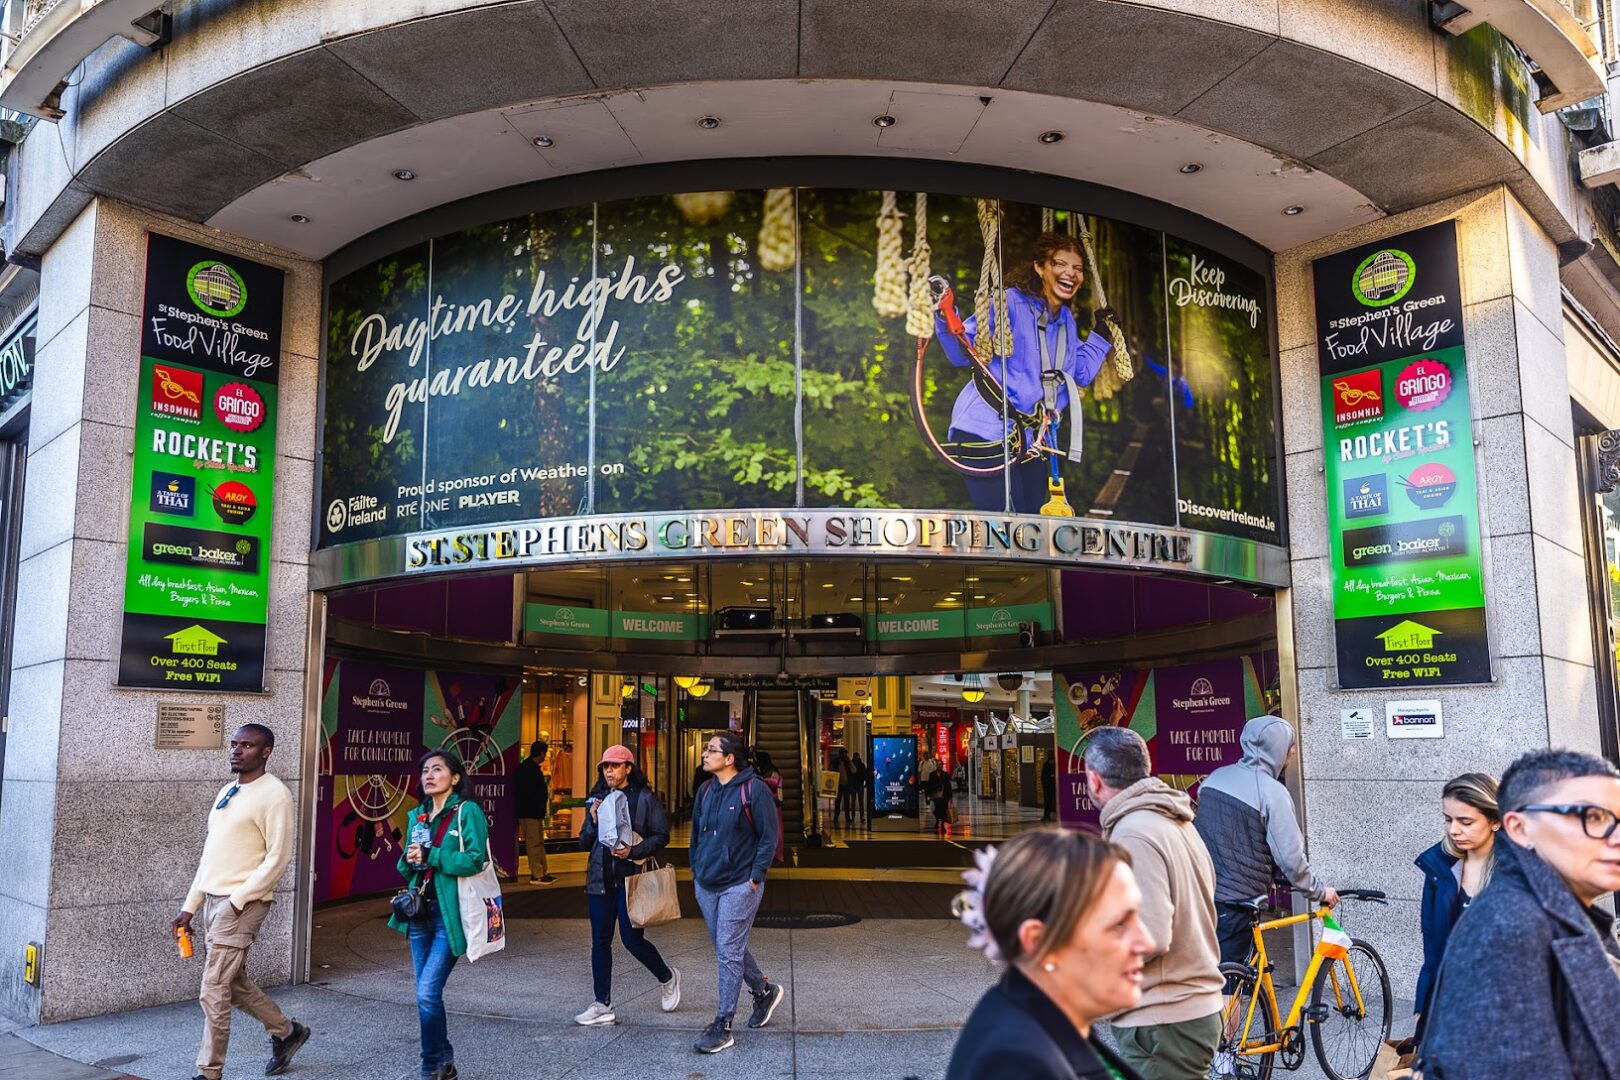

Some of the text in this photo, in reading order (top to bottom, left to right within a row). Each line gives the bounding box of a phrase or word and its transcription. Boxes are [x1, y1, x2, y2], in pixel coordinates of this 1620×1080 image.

[1191, 254, 1225, 292] Keep
[1169, 278, 1261, 329] Discovering
[1338, 305, 1400, 329] Stephen's
[1403, 295, 1446, 312] Green
[352, 255, 685, 372] Daytime highs
[167, 306, 229, 331] Stephen's
[231, 323, 269, 340] Green
[1325, 312, 1455, 360] Food Village
[152, 316, 273, 377] Food Village
[1416, 367, 1426, 375] EL
[383, 320, 626, 444] guaranteed
[1399, 373, 1446, 397] GRINGO
[236, 388, 243, 398] EL
[153, 401, 199, 418] INSOMNIA
[218, 396, 260, 417] GRINGO
[1336, 406, 1381, 422] INSOMNIA
[152, 428, 257, 469] ROCKET'S
[1340, 420, 1450, 462] ROCKET'S
[397, 480, 435, 498] Proud
[438, 473, 496, 494] sponsor
[500, 468, 517, 484] of
[601, 463, 624, 475] on
[157, 494, 189, 508] THAI
[225, 492, 248, 502] AROY
[349, 494, 377, 511] Fáilte
[458, 489, 520, 509] PLAYER
[1350, 496, 1382, 510] THAI
[348, 509, 386, 527] Ireland
[657, 515, 811, 550] GREEN
[825, 515, 1041, 552] SHOPPING
[1052, 524, 1193, 563] CENTRE
[153, 543, 192, 555] green
[198, 545, 237, 561] baker
[1352, 537, 1440, 559] green baker
[138, 574, 151, 587] All
[151, 575, 166, 592] day
[1344, 578, 1355, 592] All
[1356, 578, 1370, 594] day
[169, 590, 200, 607] Burgers
[201, 594, 208, 605] &
[1375, 589, 1406, 605] Burgers
[1407, 587, 1414, 599] &
[539, 617, 591, 629] Stephen's Green
[622, 618, 684, 633] WELCOME
[877, 619, 940, 633] WELCOME
[175, 637, 217, 654] First Floor
[1386, 633, 1432, 649] First Floor
[151, 655, 237, 671] Over 400 Seats
[1365, 652, 1457, 667] Over 400 Seats
[165, 670, 221, 683] Free WiFi
[1382, 667, 1441, 679] Free WiFi
[352, 695, 408, 709] Stephen's Green
[1172, 696, 1231, 710] Stephen's Green
[348, 729, 411, 745] TAKE A MOMENT
[1169, 729, 1236, 745] TAKE A MOMENT
[344, 746, 412, 762] FOR CONNECTION
[1186, 747, 1223, 761] FOR FUN
